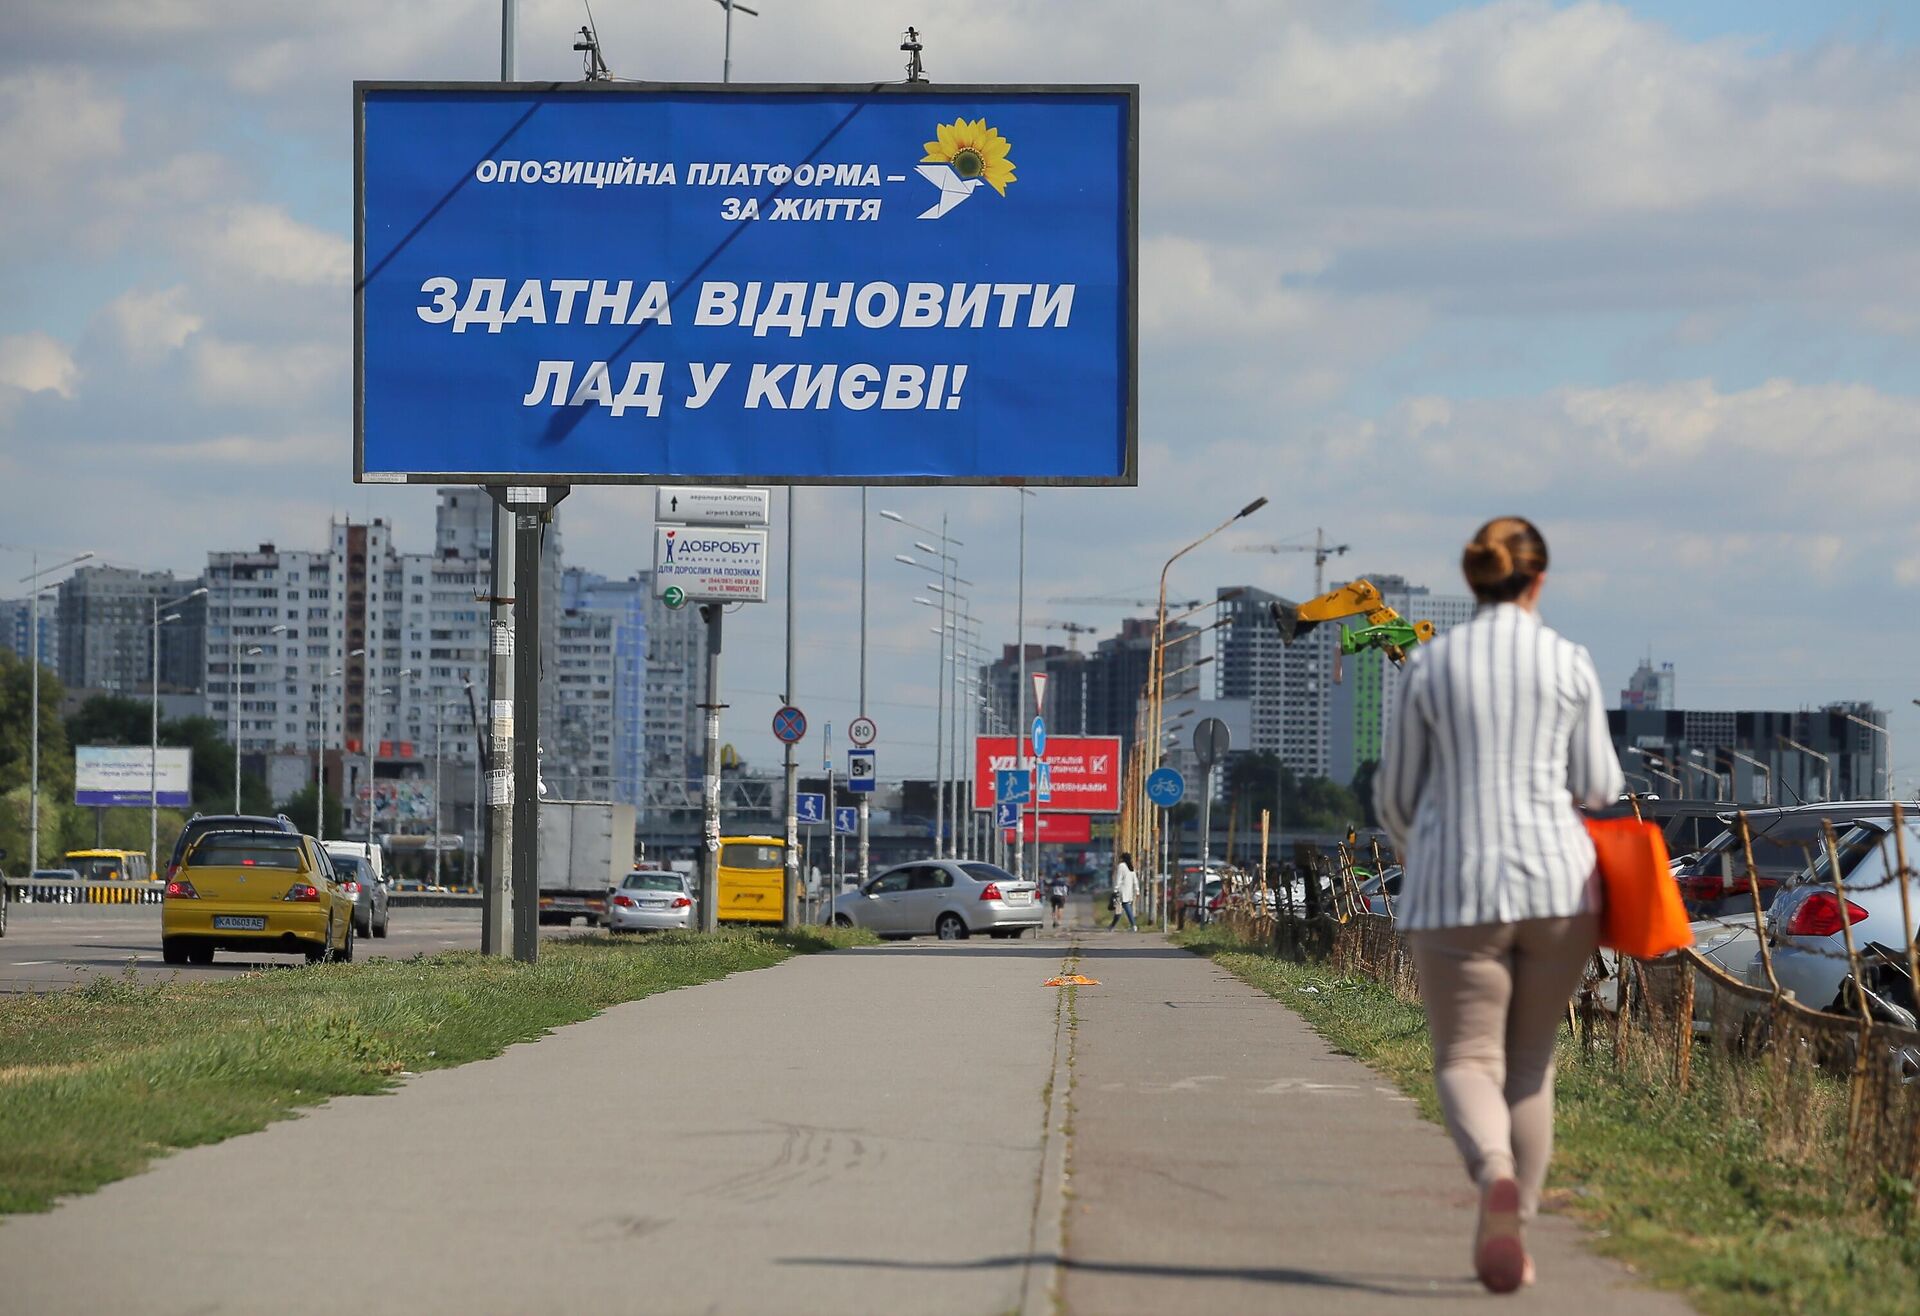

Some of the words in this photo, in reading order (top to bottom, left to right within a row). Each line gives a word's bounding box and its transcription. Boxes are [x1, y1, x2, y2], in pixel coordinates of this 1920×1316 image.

[475, 156, 677, 189] ОПОЗИЦІЙНА
[686, 163, 881, 188] ПЛАТФОРМА
[720, 197, 760, 222] ЗА
[768, 197, 882, 222] ЖИТТЯ
[416, 276, 672, 334] ЗДАТНА
[693, 281, 1077, 338] ВІДНОВИТИ
[522, 360, 665, 418] ЛАД
[684, 362, 732, 409] У
[743, 363, 968, 411] КИЄВІ!
[679, 540, 761, 554] ДОБРОБУТ
[658, 565, 673, 575] ДЛЯ
[674, 565, 711, 576] ДОРОСЛИХ
[713, 567, 723, 576] НА
[855, 726, 870, 737] 80
